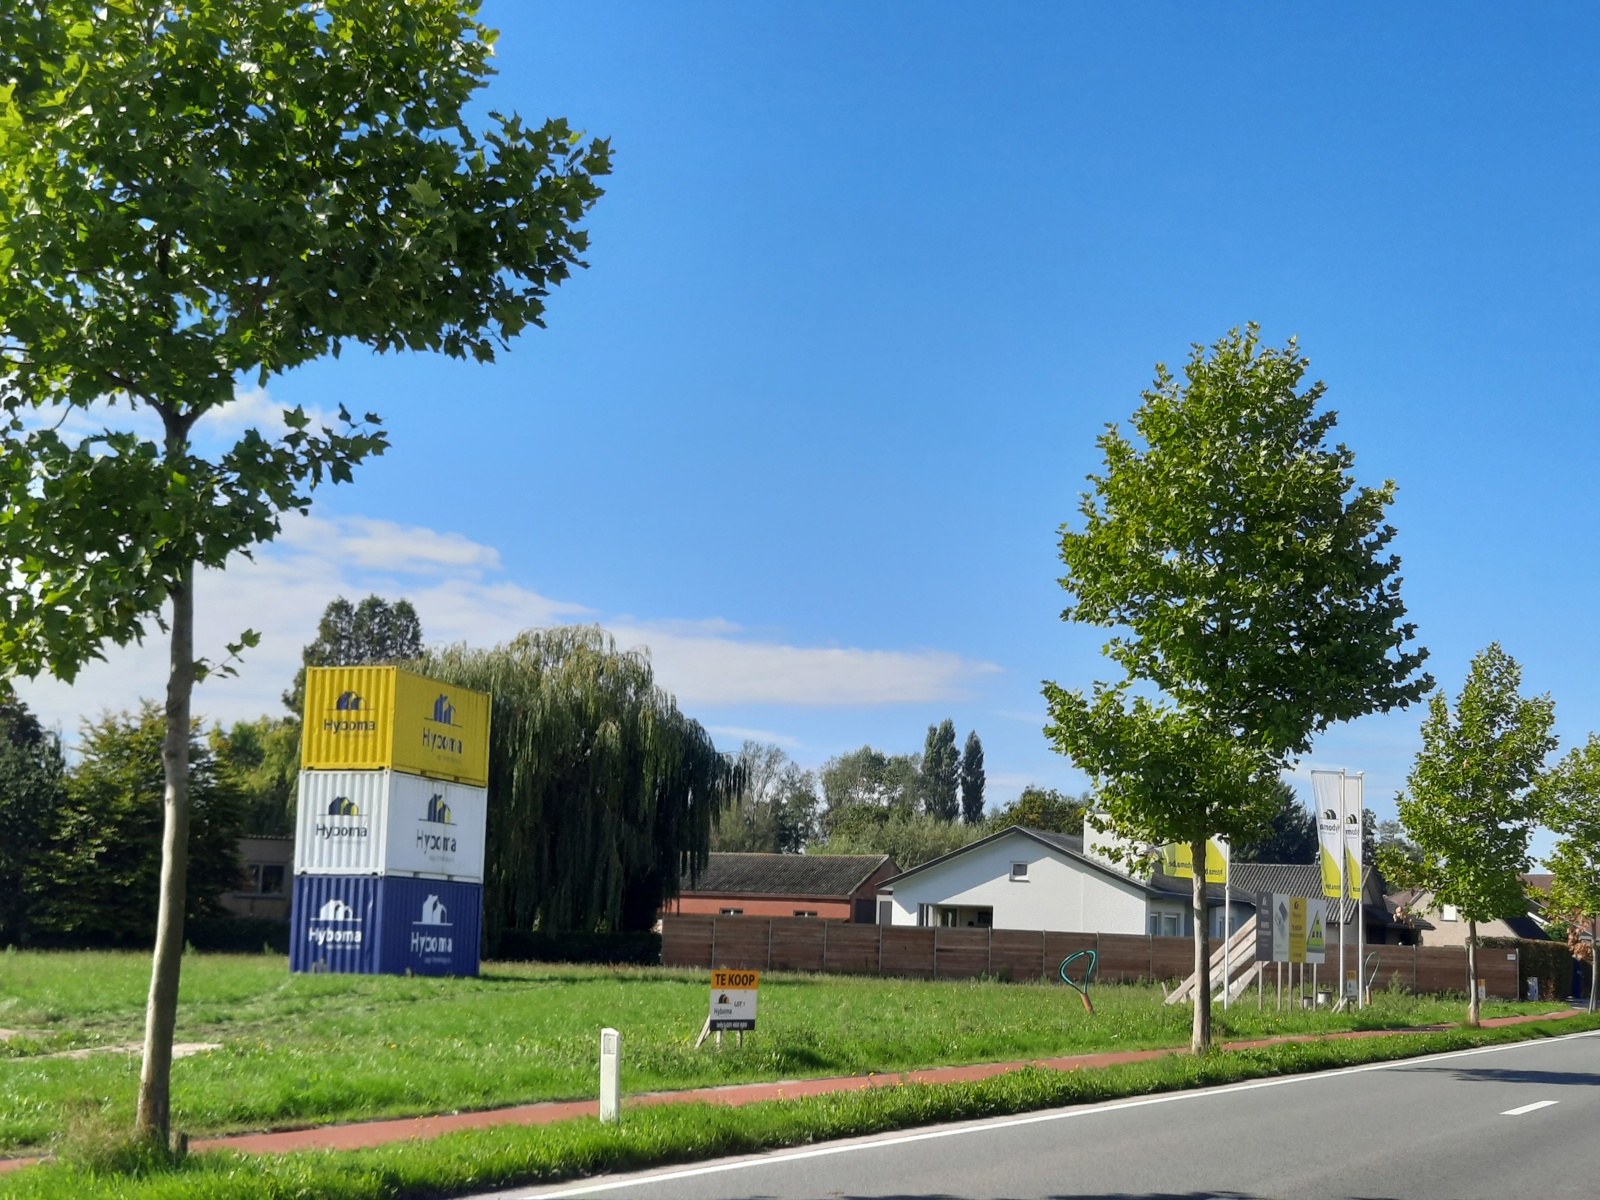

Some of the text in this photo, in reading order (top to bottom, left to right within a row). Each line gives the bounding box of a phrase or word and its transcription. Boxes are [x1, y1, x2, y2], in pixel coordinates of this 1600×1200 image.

[323, 718, 376, 734] Hyboma
[315, 823, 368, 840] Hyboma
[308, 926, 362, 946] Hyboma
[410, 931, 453, 957] Hyboma
[715, 974, 755, 986] TE KOOP
